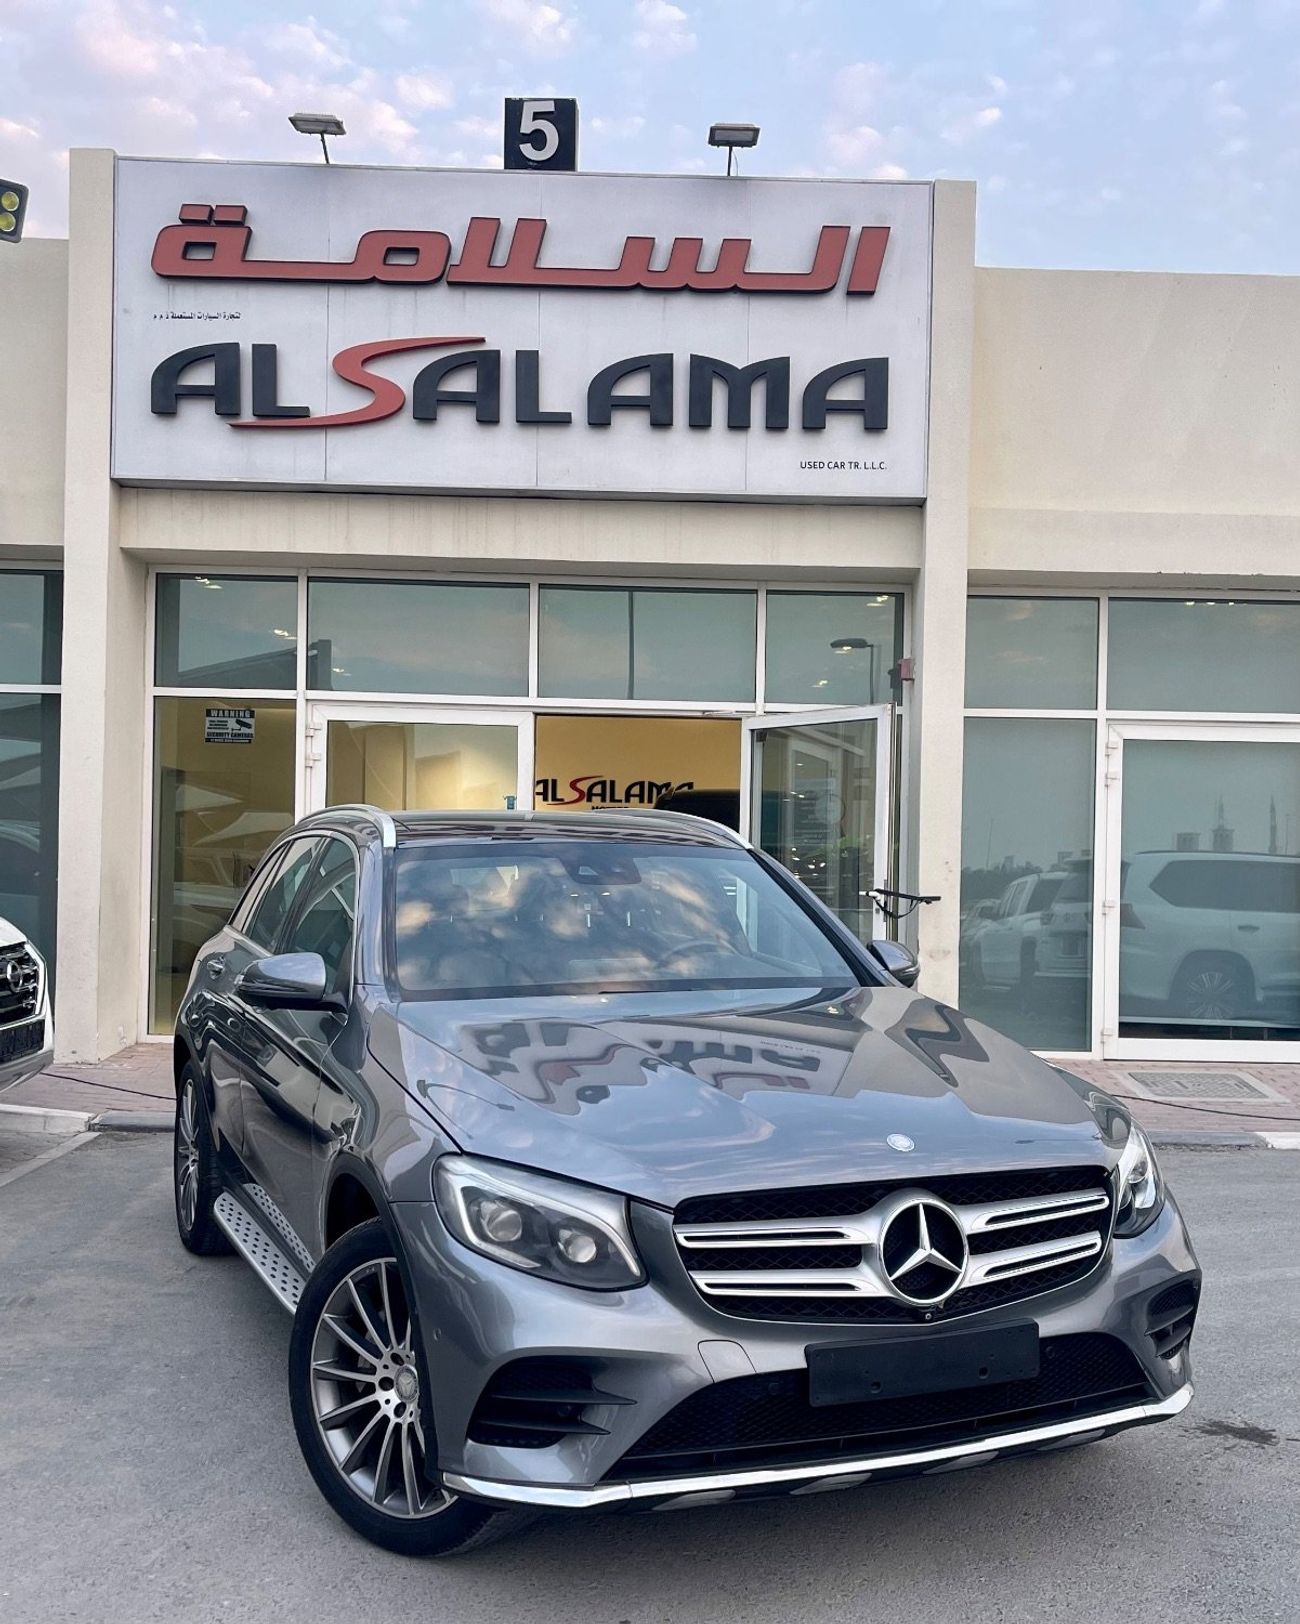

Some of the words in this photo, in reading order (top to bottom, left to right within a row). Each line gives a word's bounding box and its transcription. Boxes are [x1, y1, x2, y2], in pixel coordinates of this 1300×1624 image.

[519, 100, 559, 162] 5
[151, 203, 891, 295] السلامة
[151, 336, 889, 430] ALSALAMA
[800, 461, 825, 469] USED
[827, 461, 846, 469] CAR
[848, 461, 862, 470] TR.
[863, 461, 888, 470] L.L.C.
[210, 709, 251, 718] WARNING
